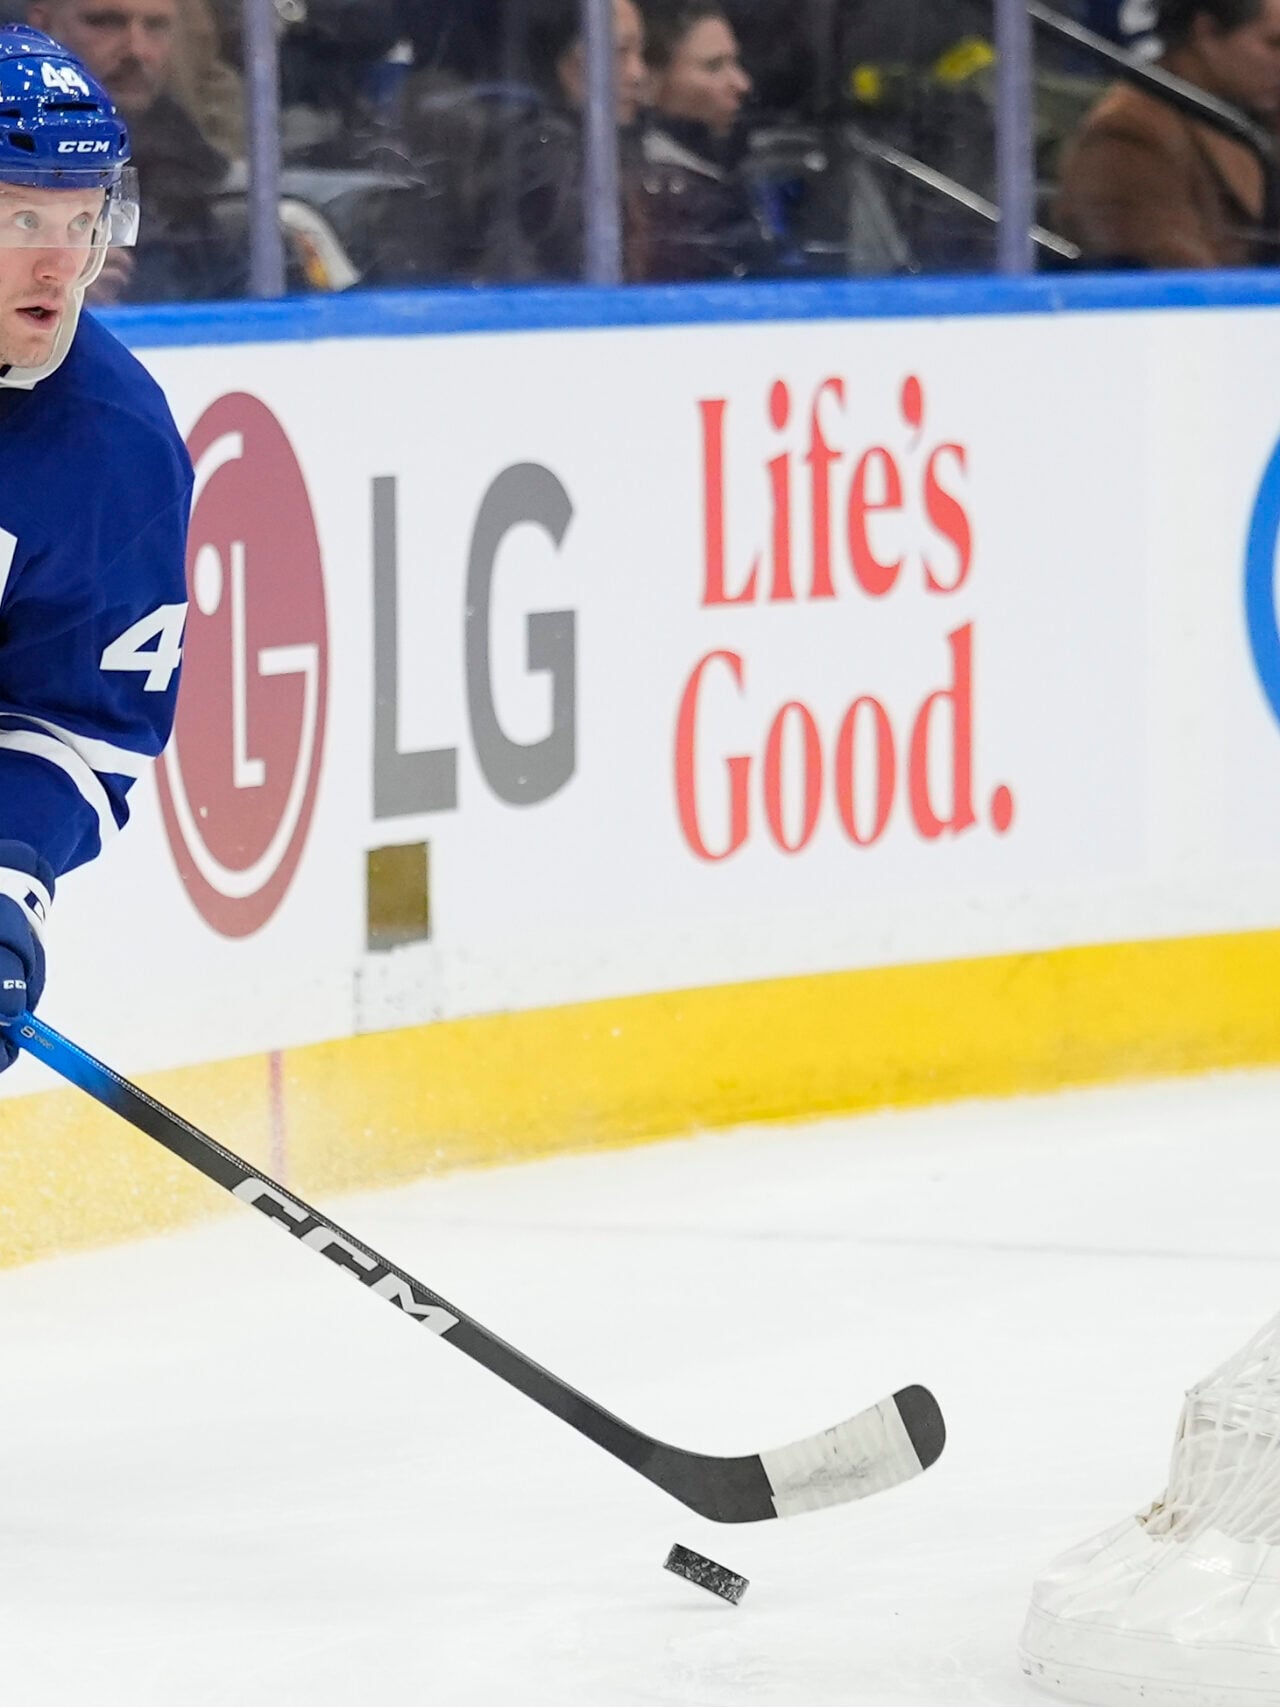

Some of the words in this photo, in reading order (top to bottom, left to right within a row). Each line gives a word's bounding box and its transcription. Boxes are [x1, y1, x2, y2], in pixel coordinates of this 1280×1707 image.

[41, 62, 90, 97] 44
[57, 140, 110, 153] CCM
[698, 375, 974, 608] Life's
[371, 462, 577, 822] LG
[674, 621, 1014, 863] Good.
[3, 979, 27, 990] CC
[231, 1176, 460, 1336] CCM
